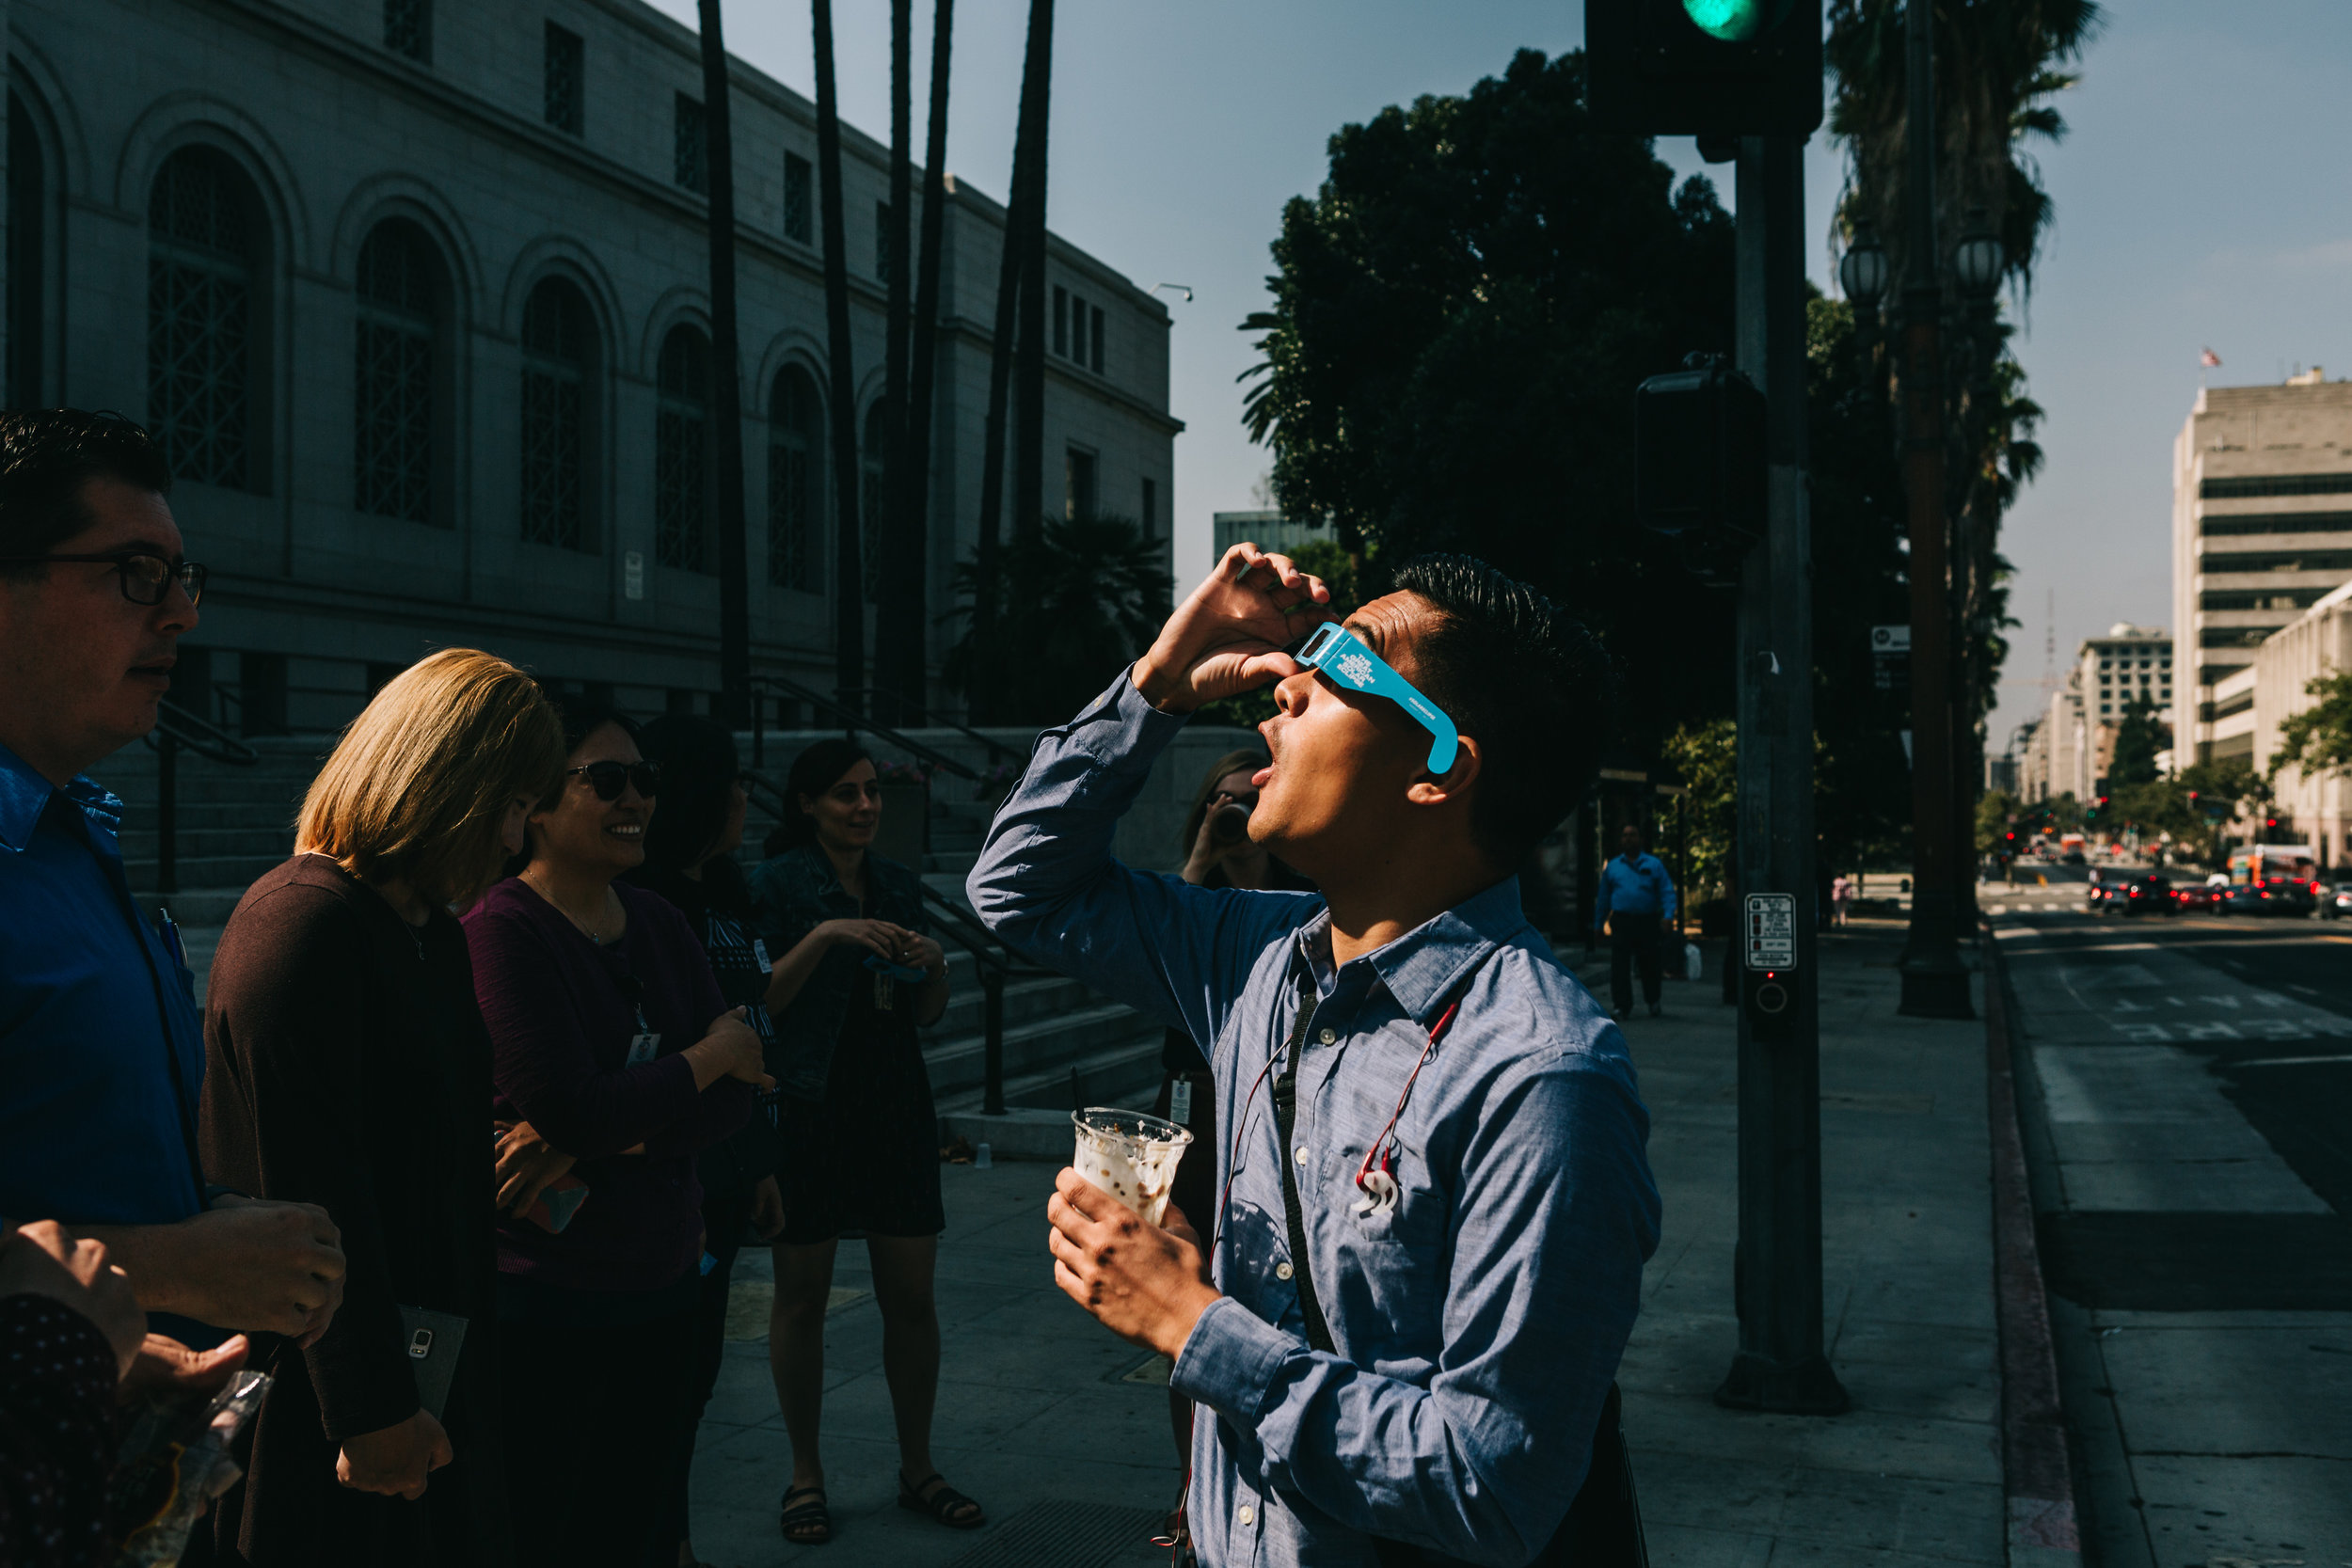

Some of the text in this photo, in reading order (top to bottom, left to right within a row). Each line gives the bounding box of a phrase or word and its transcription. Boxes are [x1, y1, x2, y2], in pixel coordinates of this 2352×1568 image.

[1340, 653, 1375, 684] AMERICAN
[1349, 654, 1373, 674] GREAT
[1357, 654, 1373, 667] THE
[1337, 663, 1364, 688] ECLIPSE
[1343, 662, 1366, 682] SOLAR
